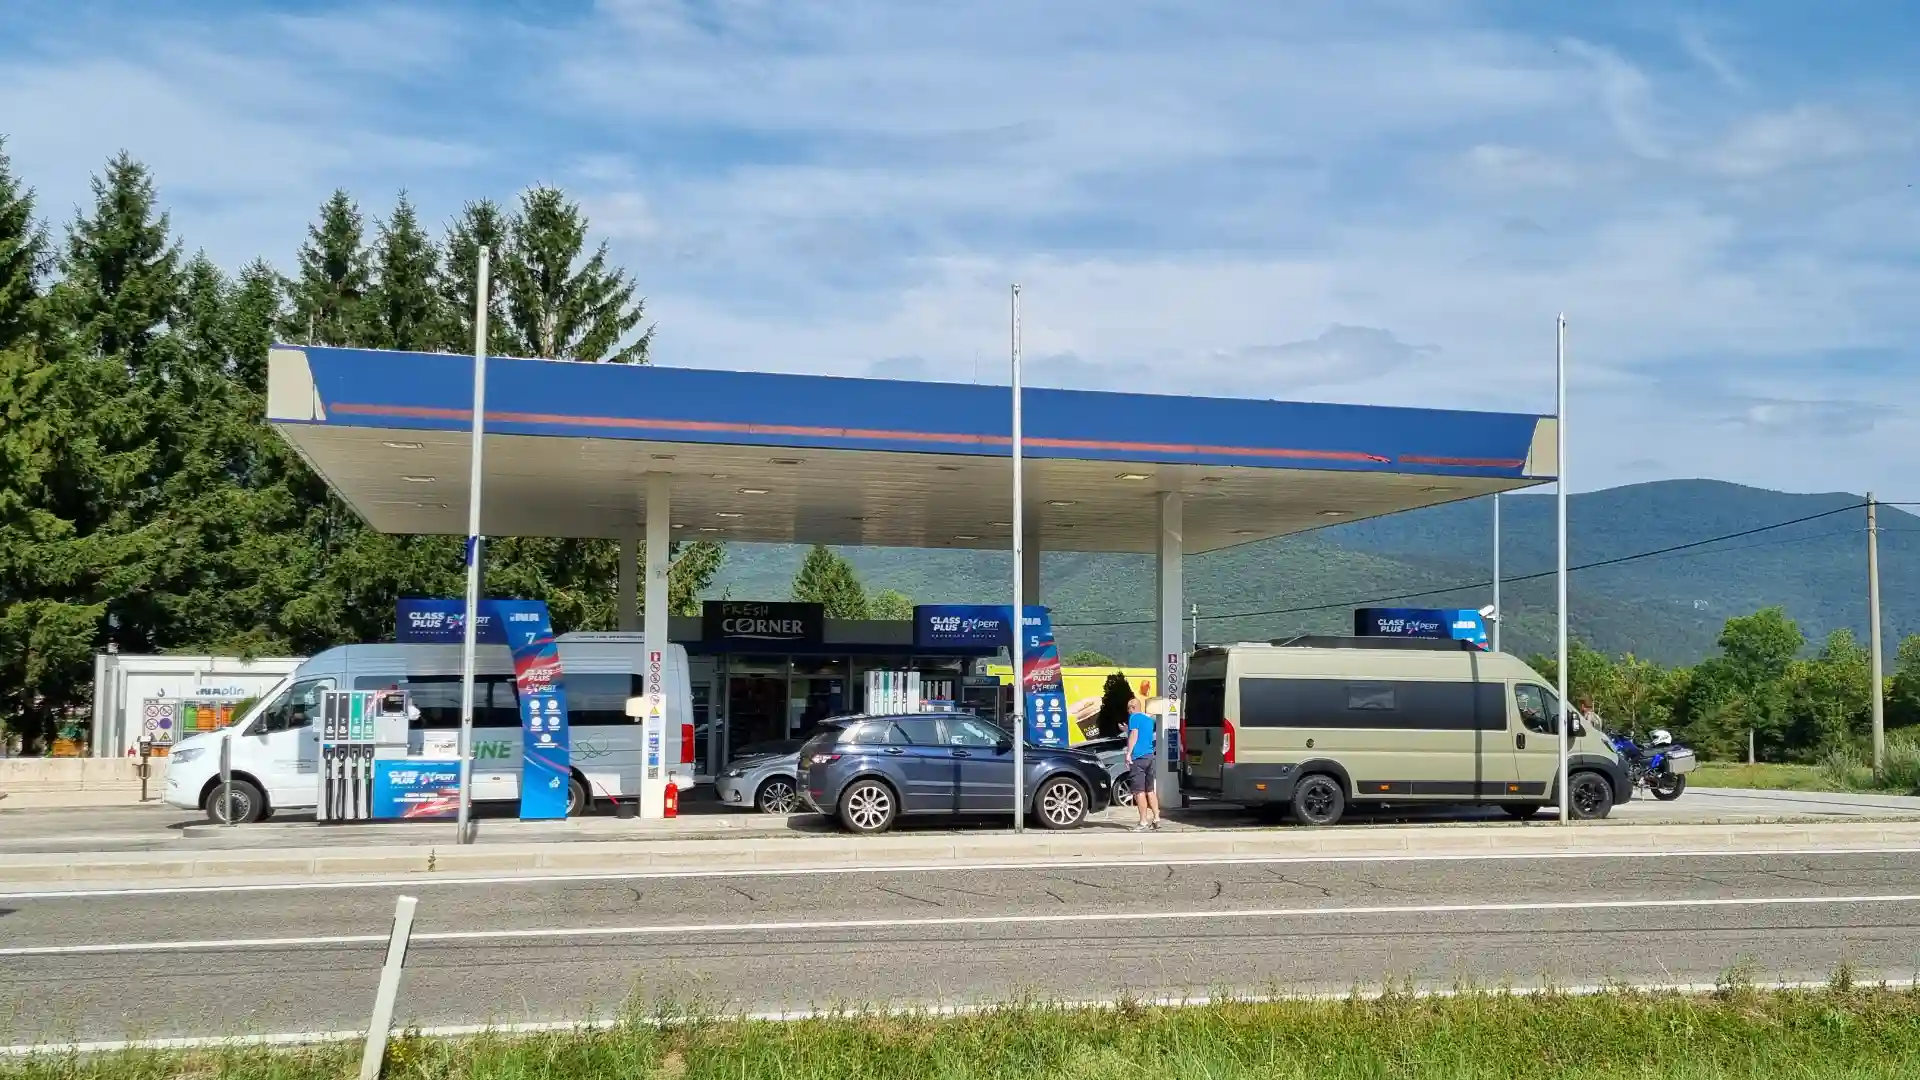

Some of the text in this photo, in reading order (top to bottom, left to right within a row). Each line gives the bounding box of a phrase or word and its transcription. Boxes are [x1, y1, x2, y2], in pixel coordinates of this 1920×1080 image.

[409, 612, 445, 620] CLASS
[722, 603, 769, 617] FRESH
[412, 620, 441, 628] PLUS
[446, 613, 491, 629] EXERT
[962, 618, 1000, 632] EXPERT
[1406, 620, 1439, 634] EXPERT
[525, 632, 536, 645] 7
[1030, 635, 1040, 647] 5
